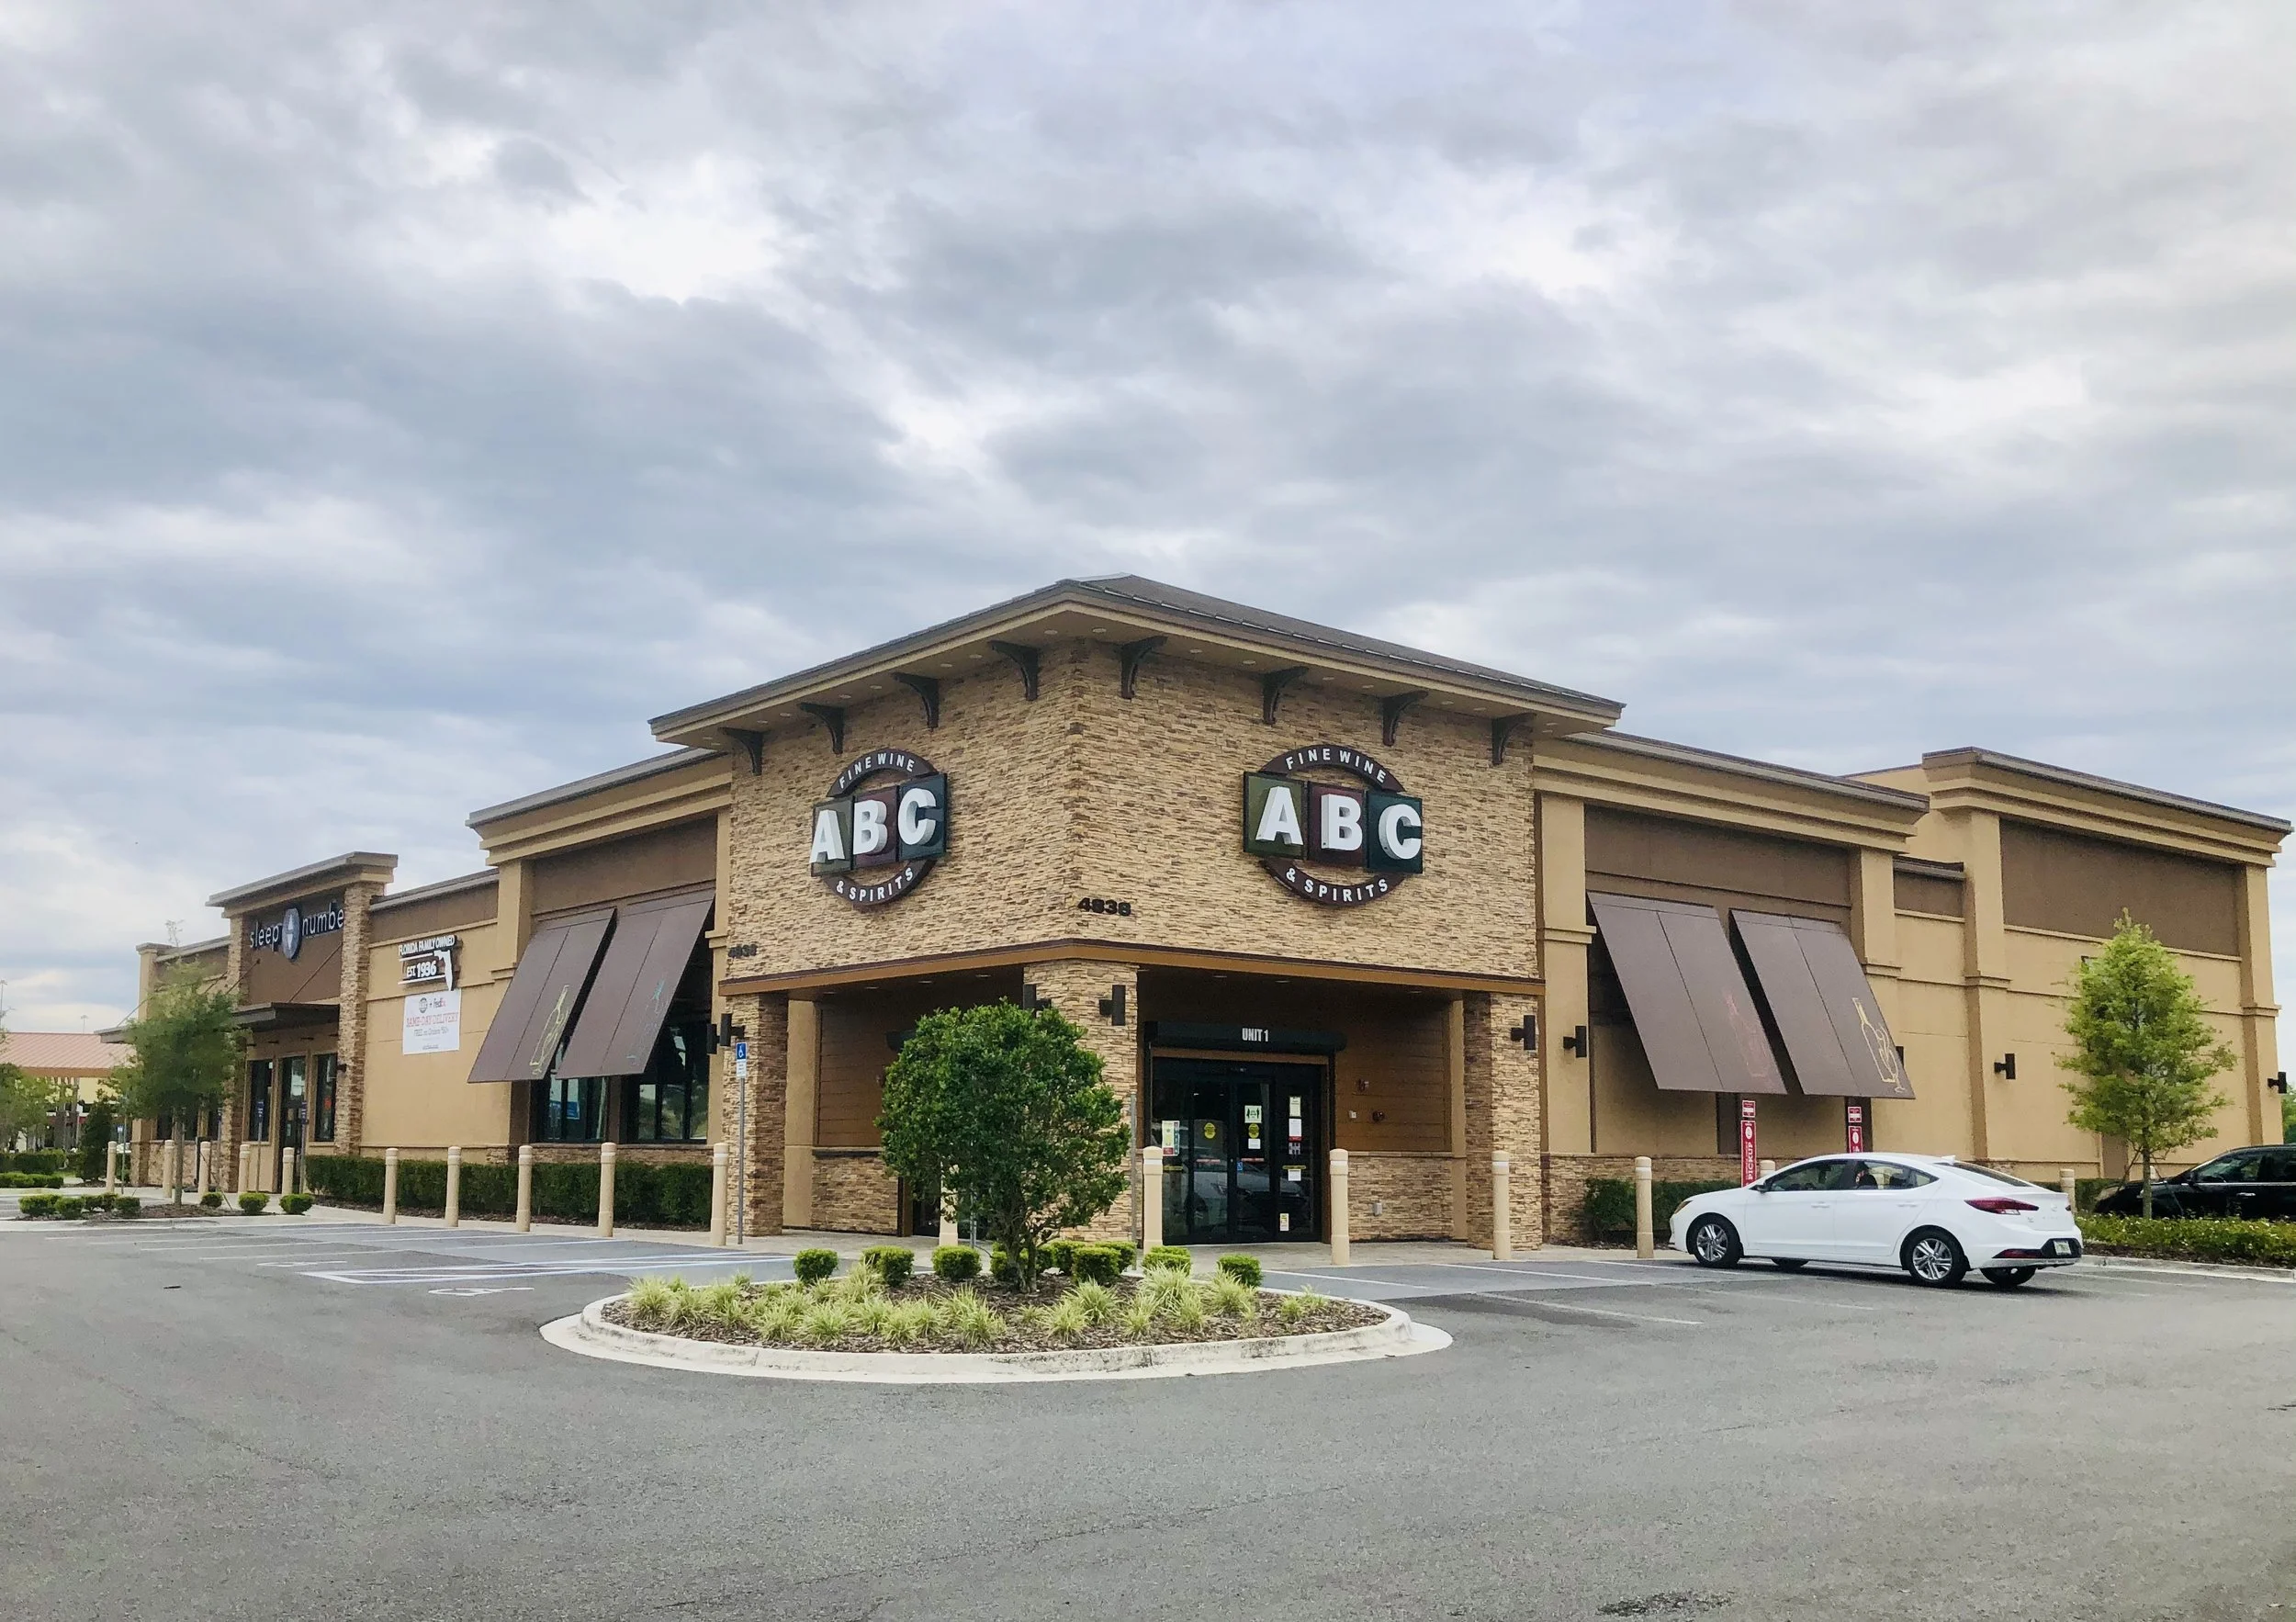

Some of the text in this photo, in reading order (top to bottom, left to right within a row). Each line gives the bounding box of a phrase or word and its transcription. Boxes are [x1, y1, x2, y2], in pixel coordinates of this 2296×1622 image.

[839, 753, 915, 789] FINE WINE
[1286, 749, 1387, 783] FINE WINE
[809, 787, 937, 863] ABC
[1255, 786, 1422, 860] ABC
[837, 867, 914, 902] & SPIRITS
[1286, 867, 1389, 902] & SPIRITS
[250, 901, 344, 952] sleep numbe
[399, 934, 456, 956] FLORIDA FAMILY OWNED
[407, 960, 437, 977] EST 1936
[1242, 1027, 1269, 1042] UNIT 1
